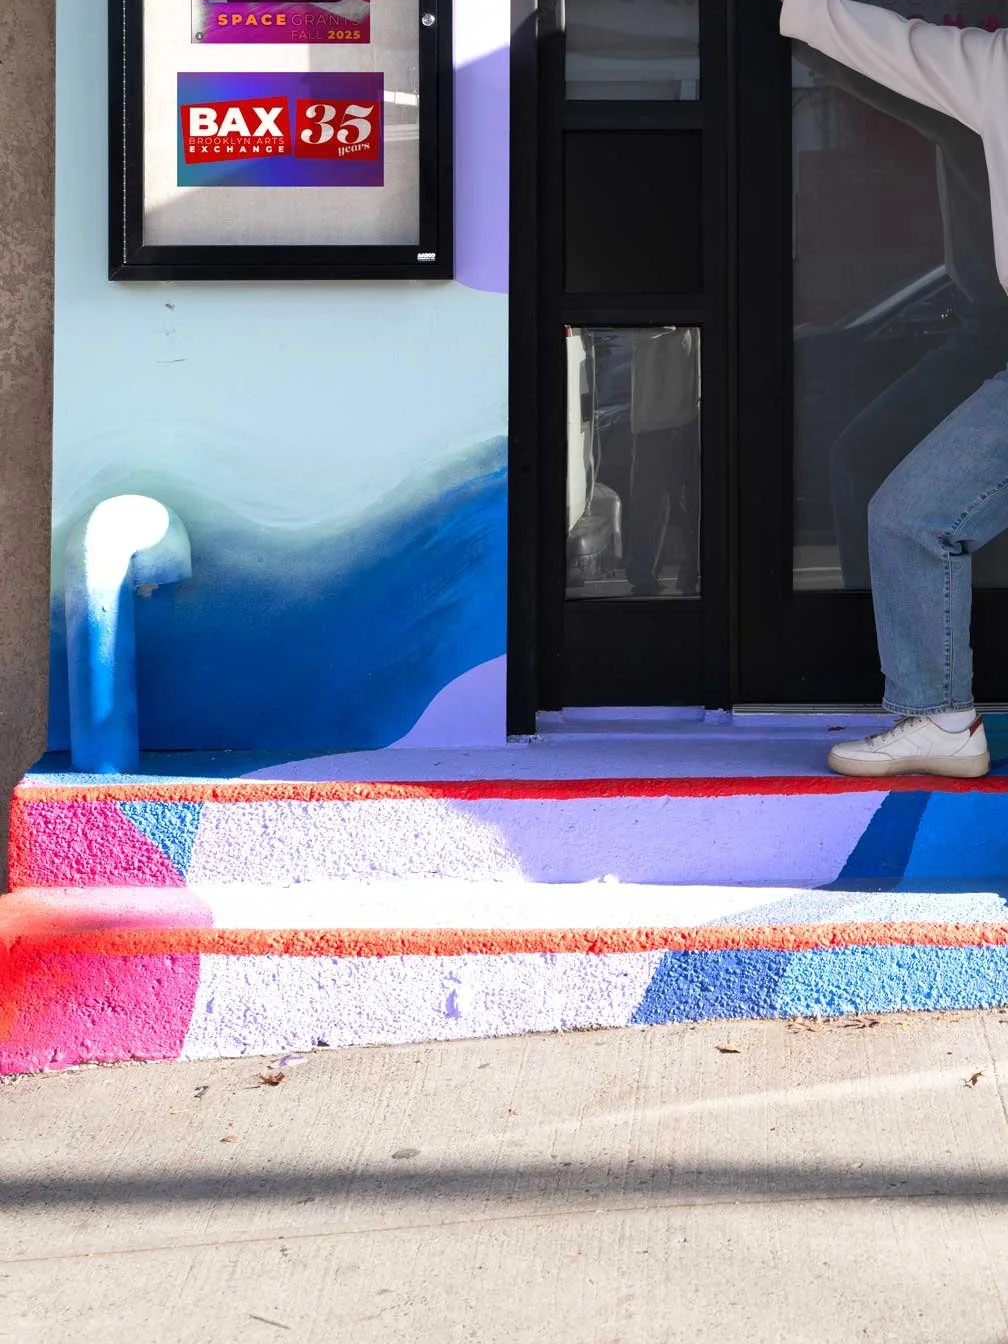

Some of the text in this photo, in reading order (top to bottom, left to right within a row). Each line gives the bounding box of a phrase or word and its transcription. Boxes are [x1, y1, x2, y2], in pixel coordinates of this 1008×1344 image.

[217, 13, 361, 26] SPACE GRANTS
[291, 30, 361, 40] FALL 2025
[189, 104, 375, 145] BAX 35
[188, 137, 285, 145] BROOKLYN ARTS
[189, 145, 285, 153] EXCHANGE
[338, 141, 371, 157] years
